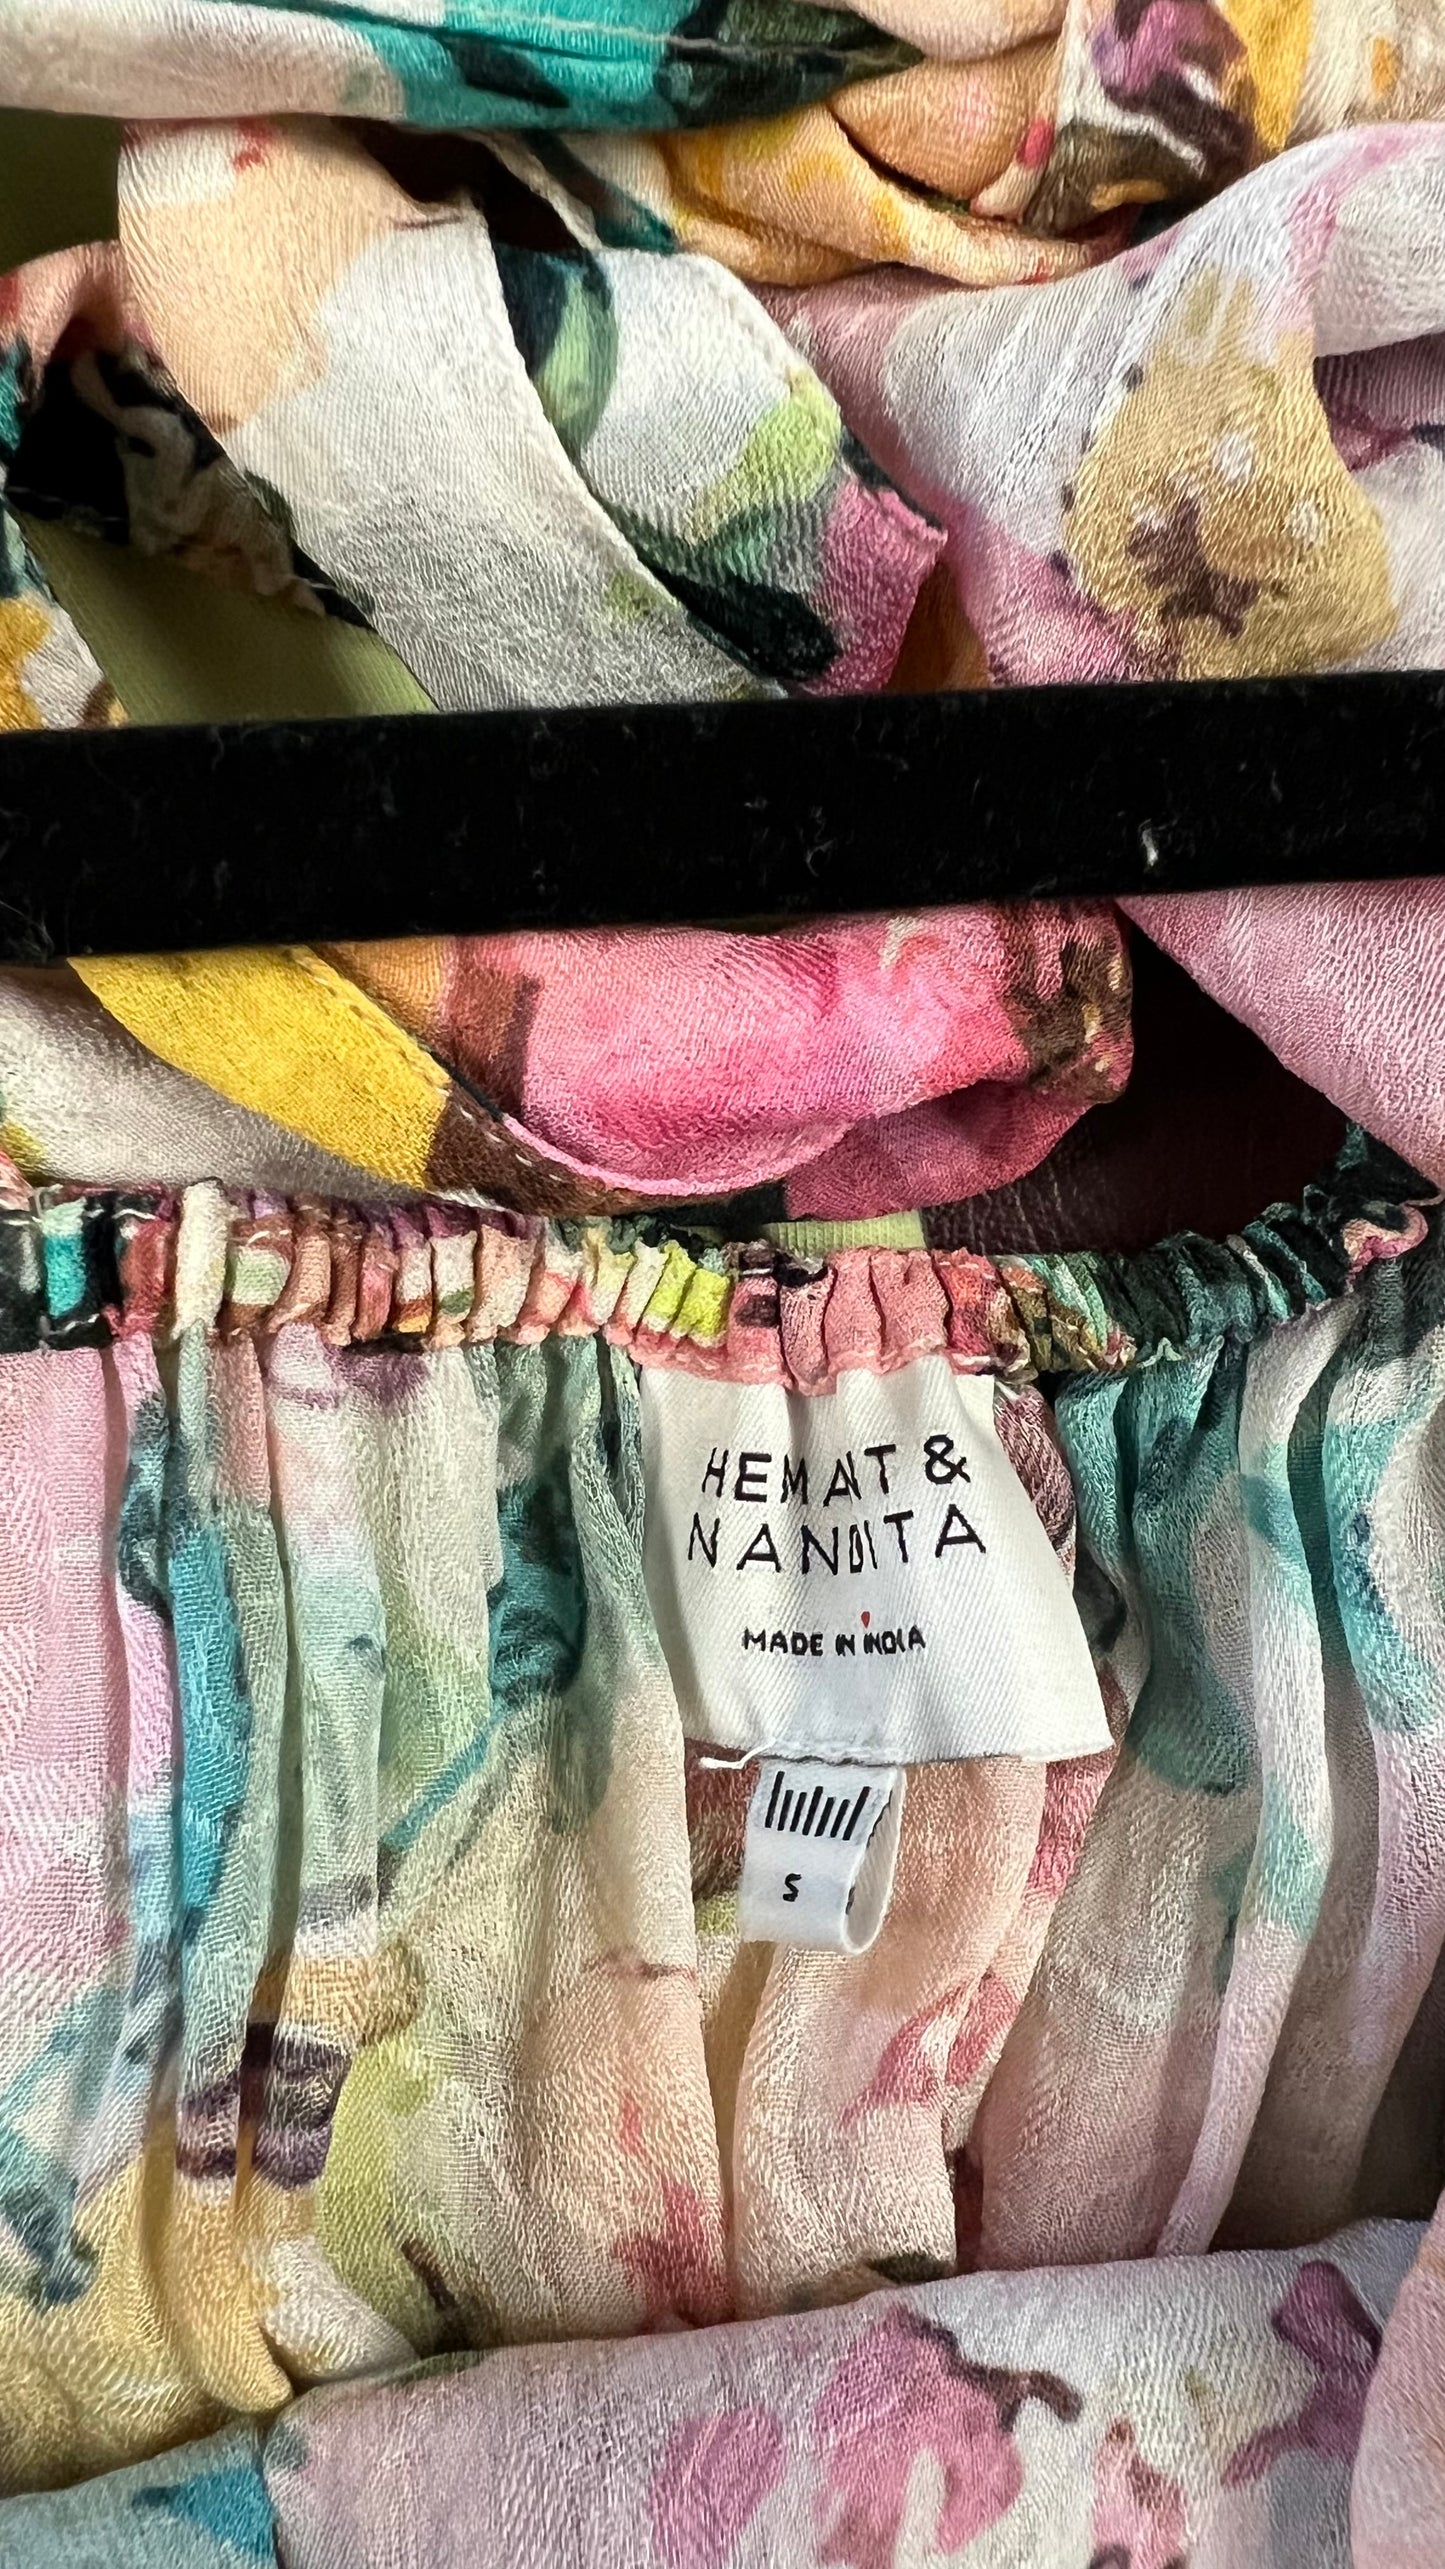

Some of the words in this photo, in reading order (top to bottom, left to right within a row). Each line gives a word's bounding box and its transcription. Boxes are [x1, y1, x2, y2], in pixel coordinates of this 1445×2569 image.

[924, 1433, 971, 1486] &
[687, 1504, 987, 1576] NANDITA
[741, 1626, 824, 1657] MADE
[782, 1873, 802, 1902] S
